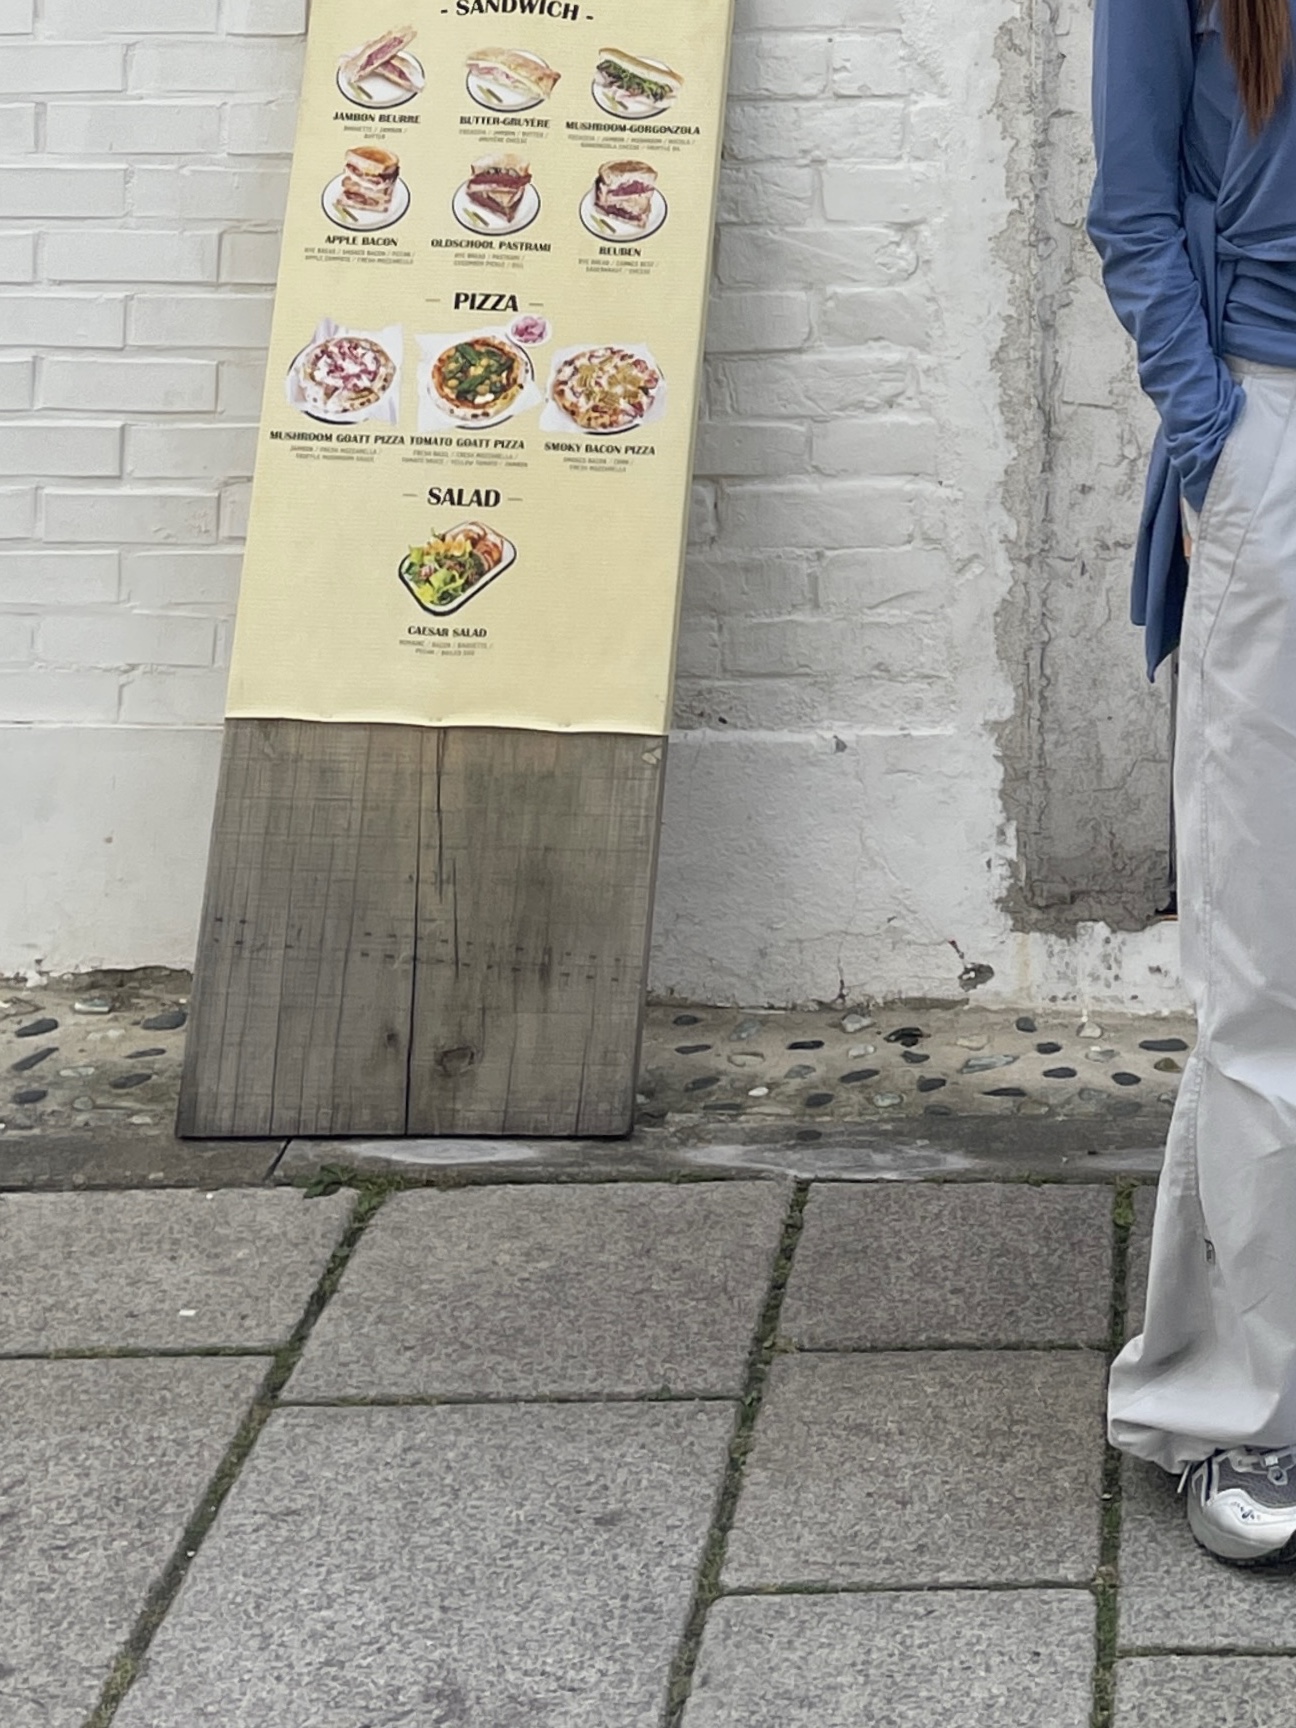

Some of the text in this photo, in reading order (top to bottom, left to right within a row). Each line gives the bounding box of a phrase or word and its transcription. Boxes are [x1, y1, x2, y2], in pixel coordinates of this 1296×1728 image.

[332, 112, 376, 123] JAMBON
[325, 234, 398, 247] APPLE BACON
[430, 238, 552, 253] OLDSCHOOL PASTRAMI
[453, 292, 520, 313] PIZZA
[269, 430, 333, 443] MUSHROOM
[373, 434, 406, 445] PIZZA
[409, 435, 453, 447] TOMATO
[493, 439, 525, 450] PIZZA
[544, 441, 656, 456] SMOKY BACON PIZZA
[427, 487, 501, 508] SALAD
[452, 627, 487, 638] SALAD
